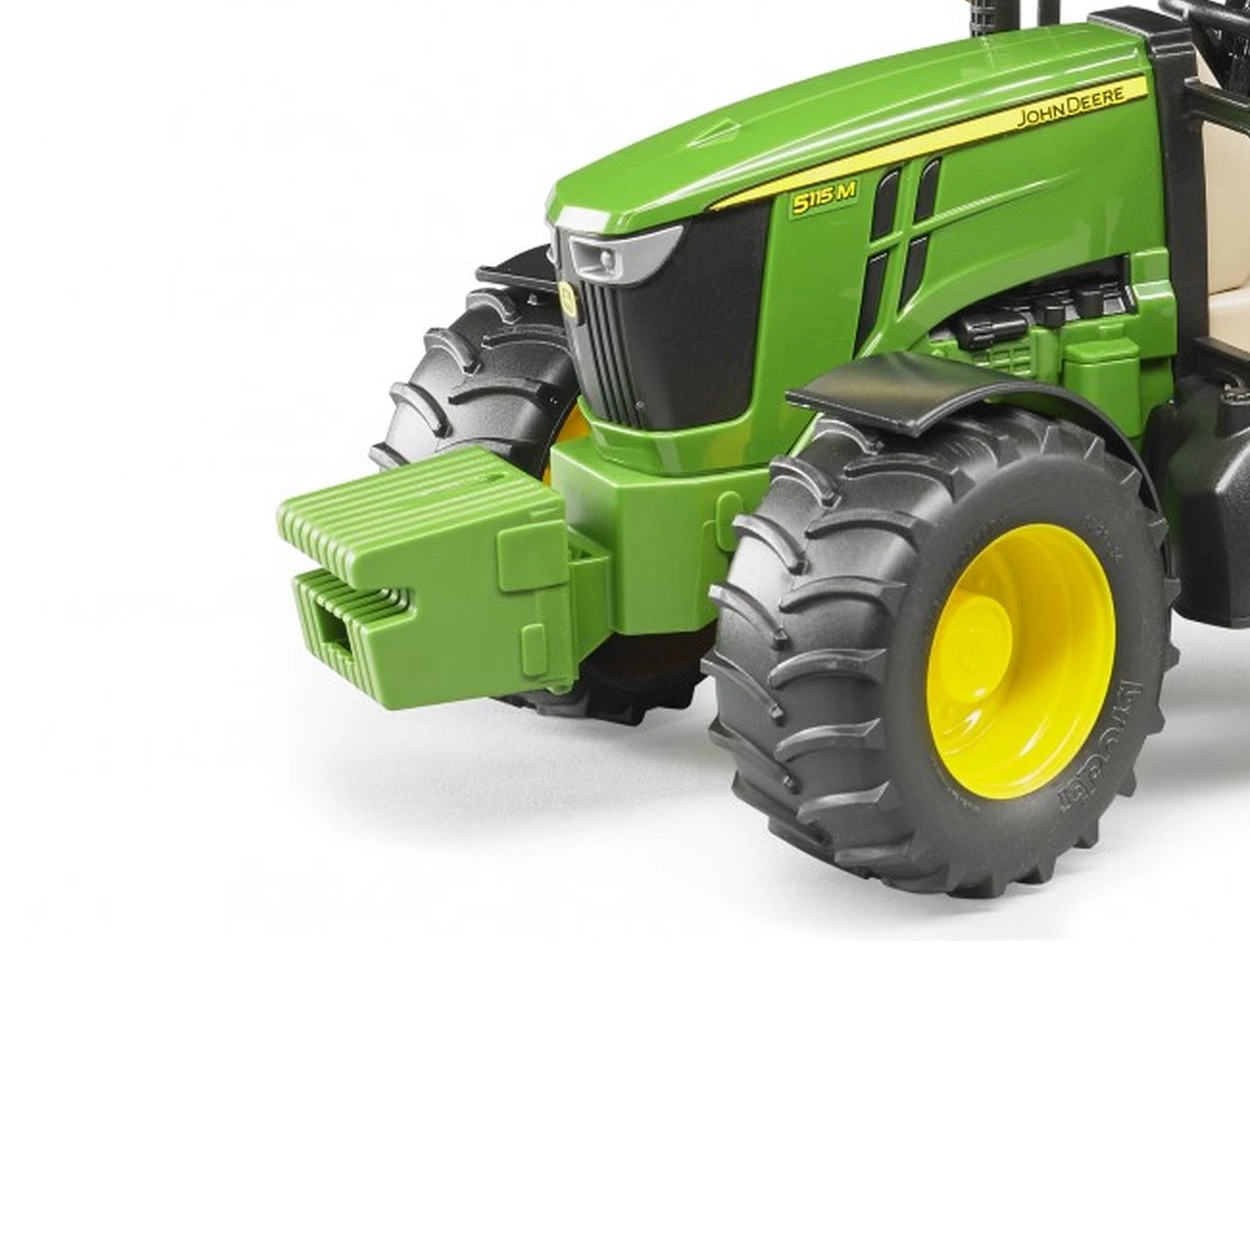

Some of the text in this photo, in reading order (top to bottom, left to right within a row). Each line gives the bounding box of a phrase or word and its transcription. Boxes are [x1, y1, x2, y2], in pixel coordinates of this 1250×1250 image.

[1017, 86, 1124, 127] JOHN DEERE
[793, 180, 857, 215] 5115 M
